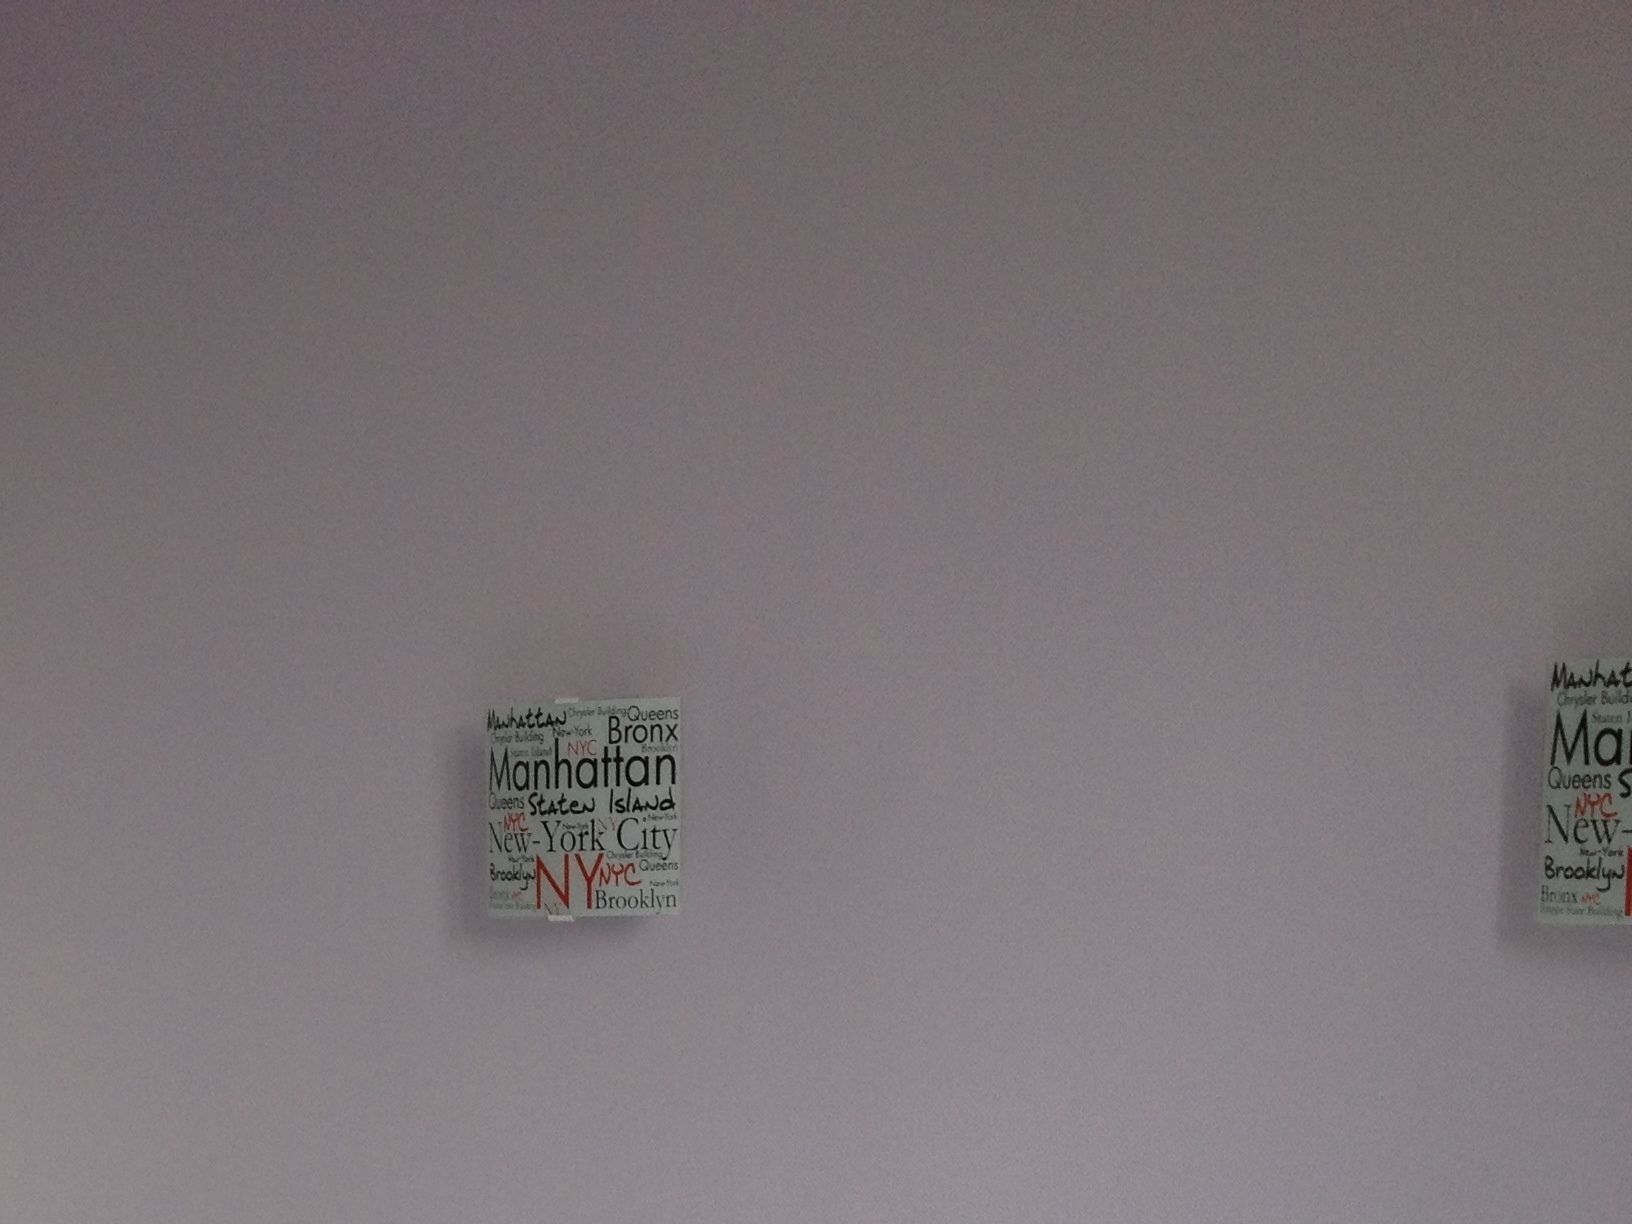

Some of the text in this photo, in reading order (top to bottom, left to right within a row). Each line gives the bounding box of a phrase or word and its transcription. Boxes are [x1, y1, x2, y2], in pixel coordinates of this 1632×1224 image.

[627, 705, 679, 721] Queens
[608, 715, 680, 745] Bronx
[568, 739, 598, 757] NYC
[488, 737, 677, 792] Manhattan
[1548, 766, 1613, 791] Queens
[1574, 792, 1618, 819] NYC
[616, 816, 678, 861] City
[598, 861, 642, 888] NYC
[638, 859, 679, 872] Queens
[1544, 854, 1625, 893] Brooklyn
[594, 887, 677, 915] Brooklyn
